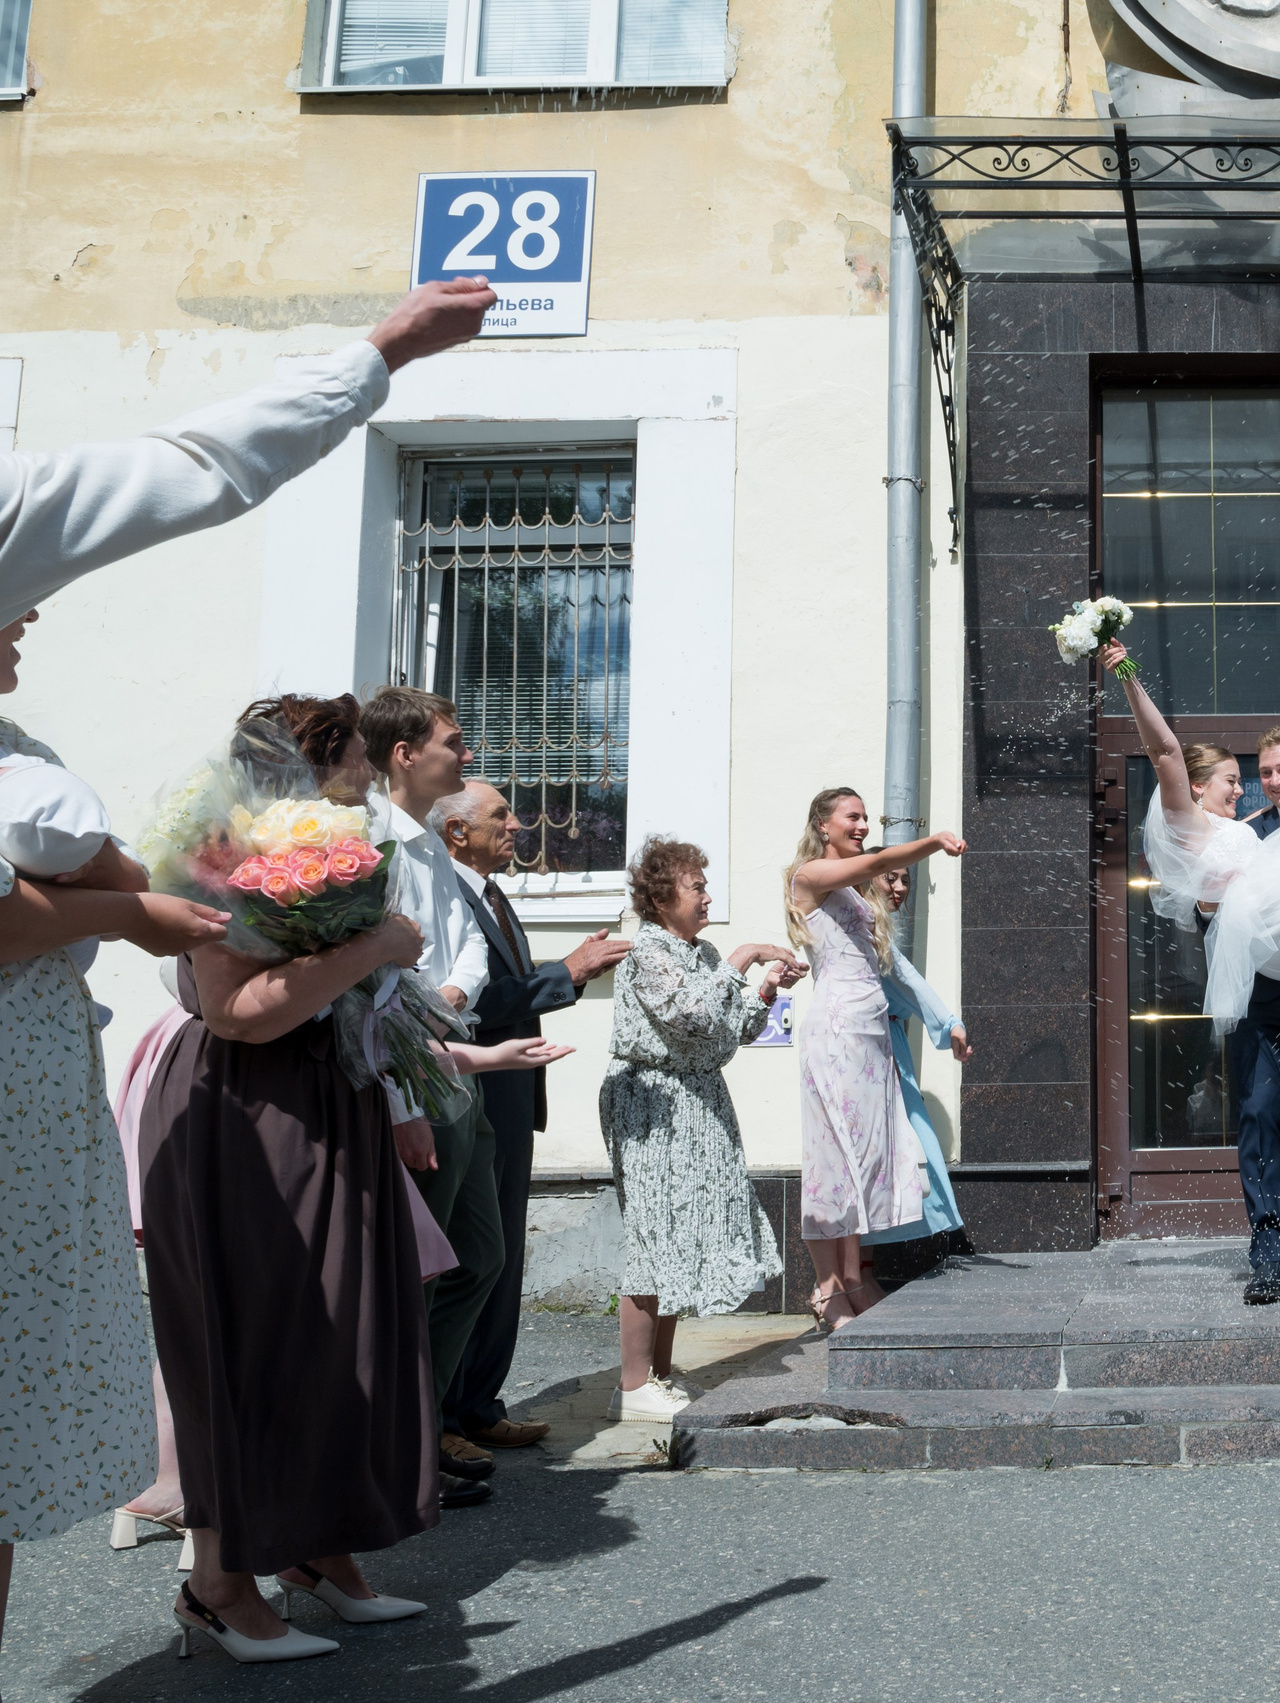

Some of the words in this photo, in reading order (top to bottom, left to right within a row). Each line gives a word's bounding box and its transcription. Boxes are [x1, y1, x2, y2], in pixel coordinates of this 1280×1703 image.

[441, 190, 561, 271] 28
[485, 298, 554, 311] льева
[482, 317, 517, 328] лица
